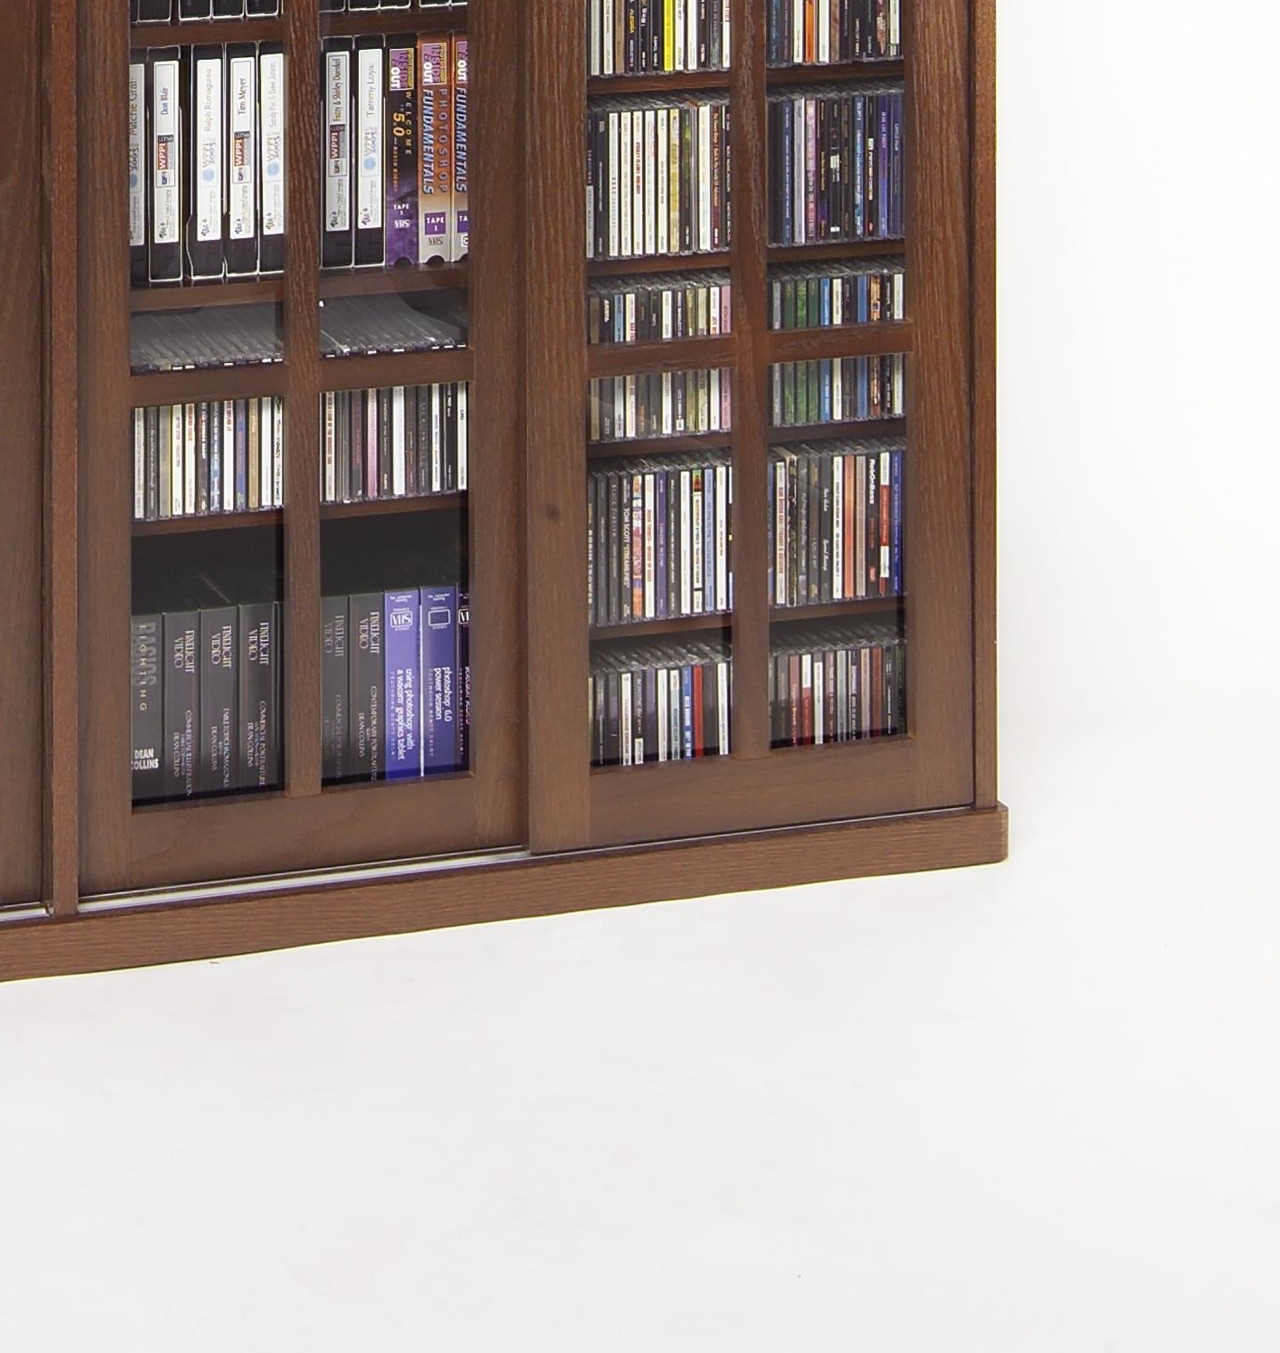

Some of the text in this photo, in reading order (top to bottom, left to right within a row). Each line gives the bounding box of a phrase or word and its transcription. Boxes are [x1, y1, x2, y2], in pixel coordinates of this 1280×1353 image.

[391, 67, 401, 89] OUT
[423, 62, 434, 84] OUT
[457, 60, 467, 82] OUT
[235, 139, 243, 165] WPPI
[331, 132, 339, 158] WPPI
[422, 89, 434, 194] FUNDAMENTALS
[439, 88, 448, 193] PHOTOSHOP
[455, 88, 467, 193] FUNDAMENTALS
[159, 143, 167, 168] WPPI
[212, 634, 221, 664] VIDEO
[248, 629, 258, 660] VIDEO
[433, 668, 442, 689] power
[442, 667, 453, 706] photoshop
[405, 690, 415, 728] photoshop
[135, 748, 154, 759] DEAN
